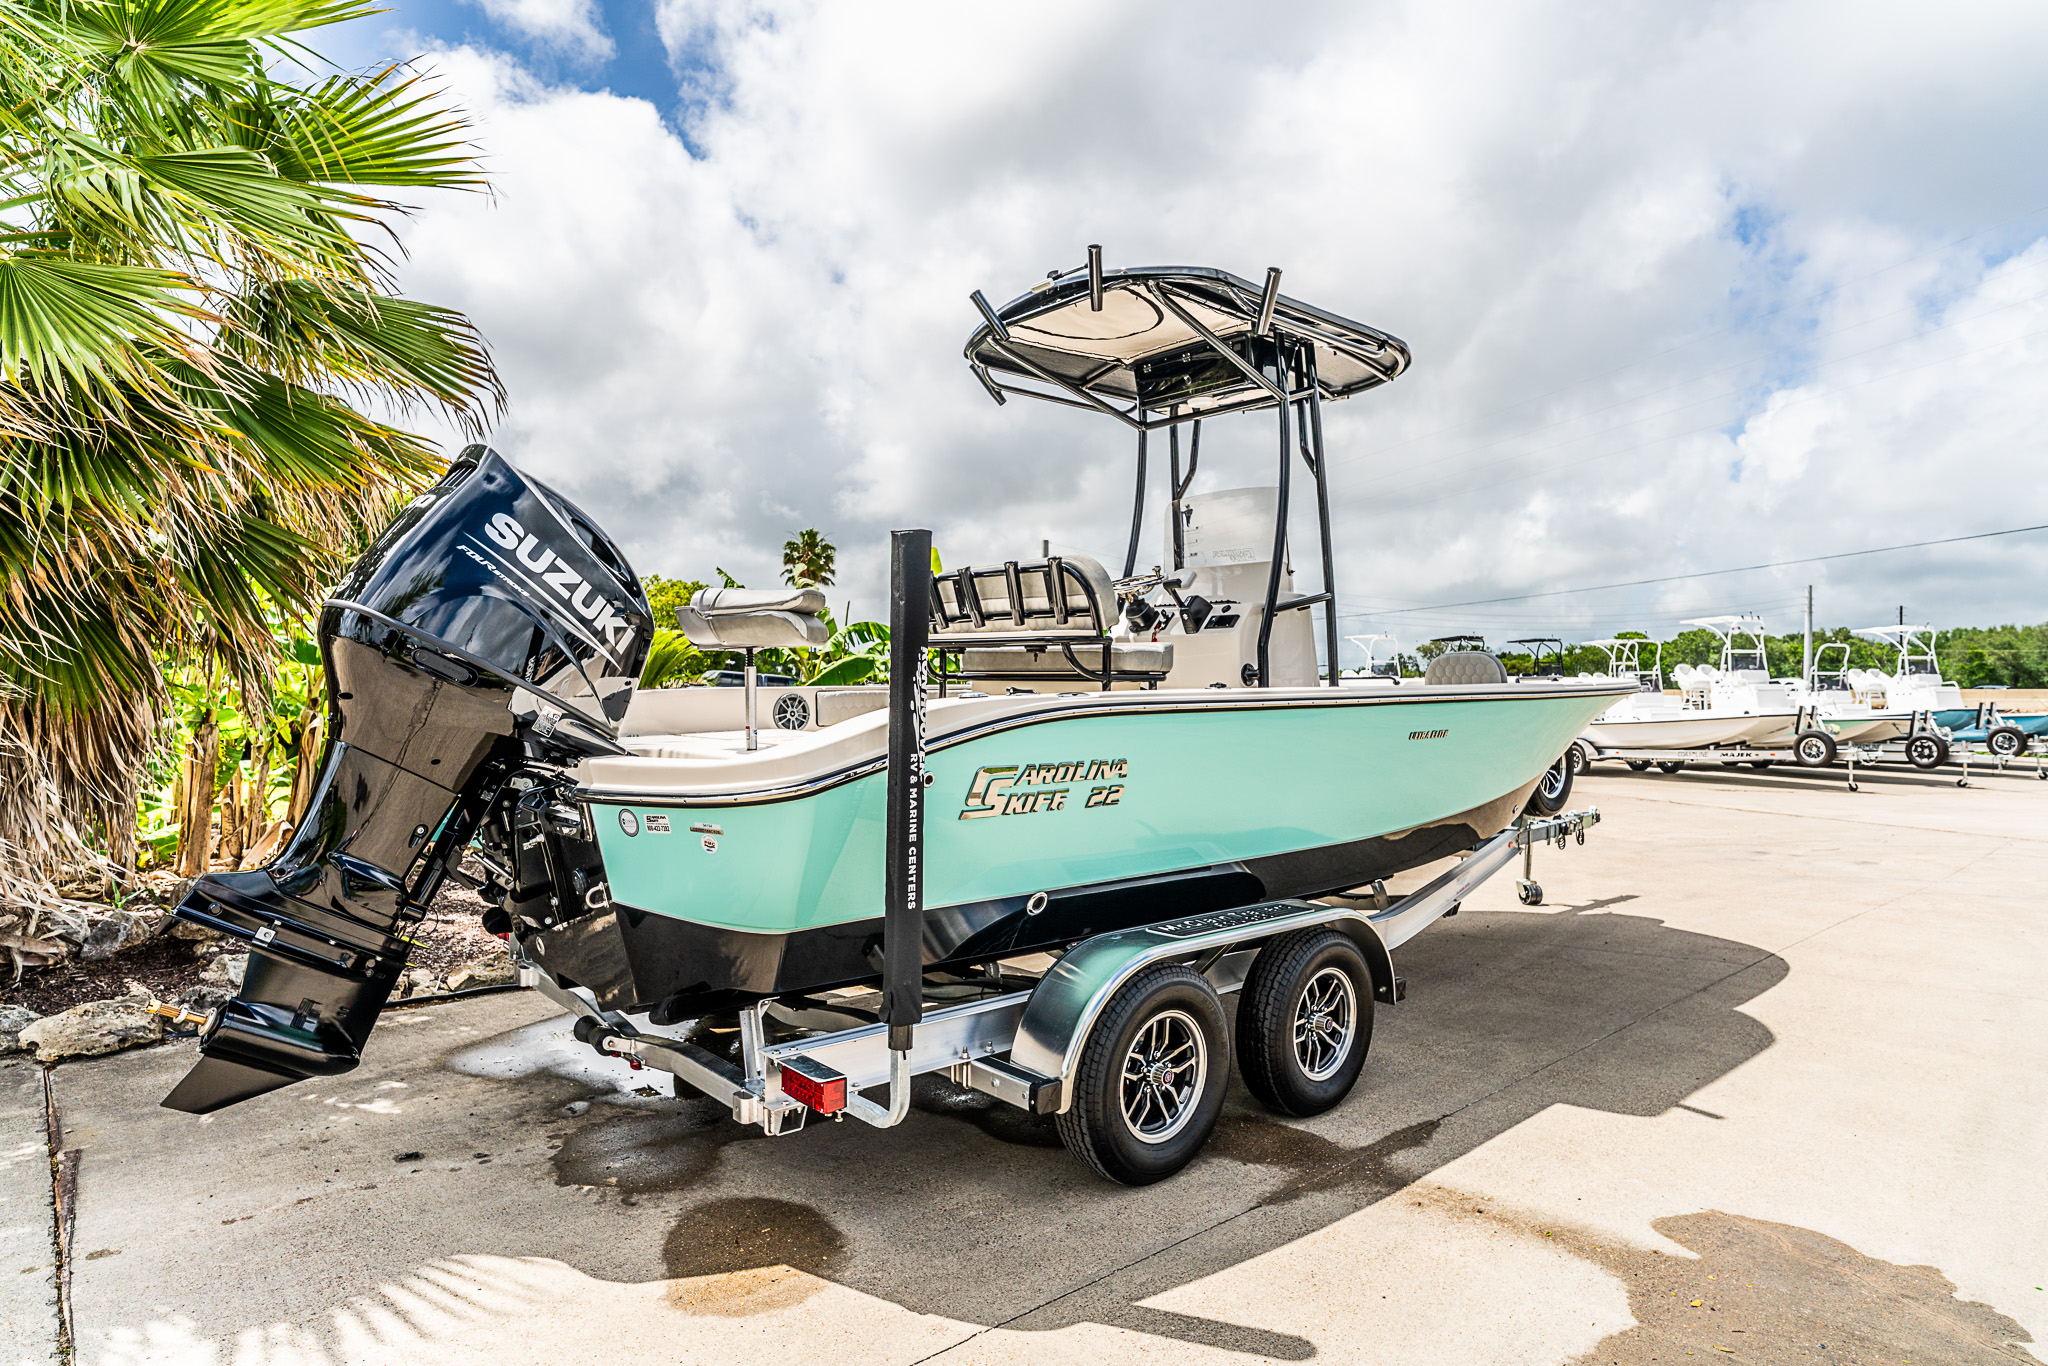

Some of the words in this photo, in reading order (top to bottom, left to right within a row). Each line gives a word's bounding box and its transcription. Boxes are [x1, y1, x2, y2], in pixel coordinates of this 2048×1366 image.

[484, 512, 636, 655] SUZUKI
[909, 775, 918, 784] &
[910, 753, 918, 772] RV
[965, 758, 1128, 806] CAROLINA
[908, 787, 918, 842] MARINE
[1085, 784, 1126, 808] 22
[907, 846, 917, 910] CENTERS
